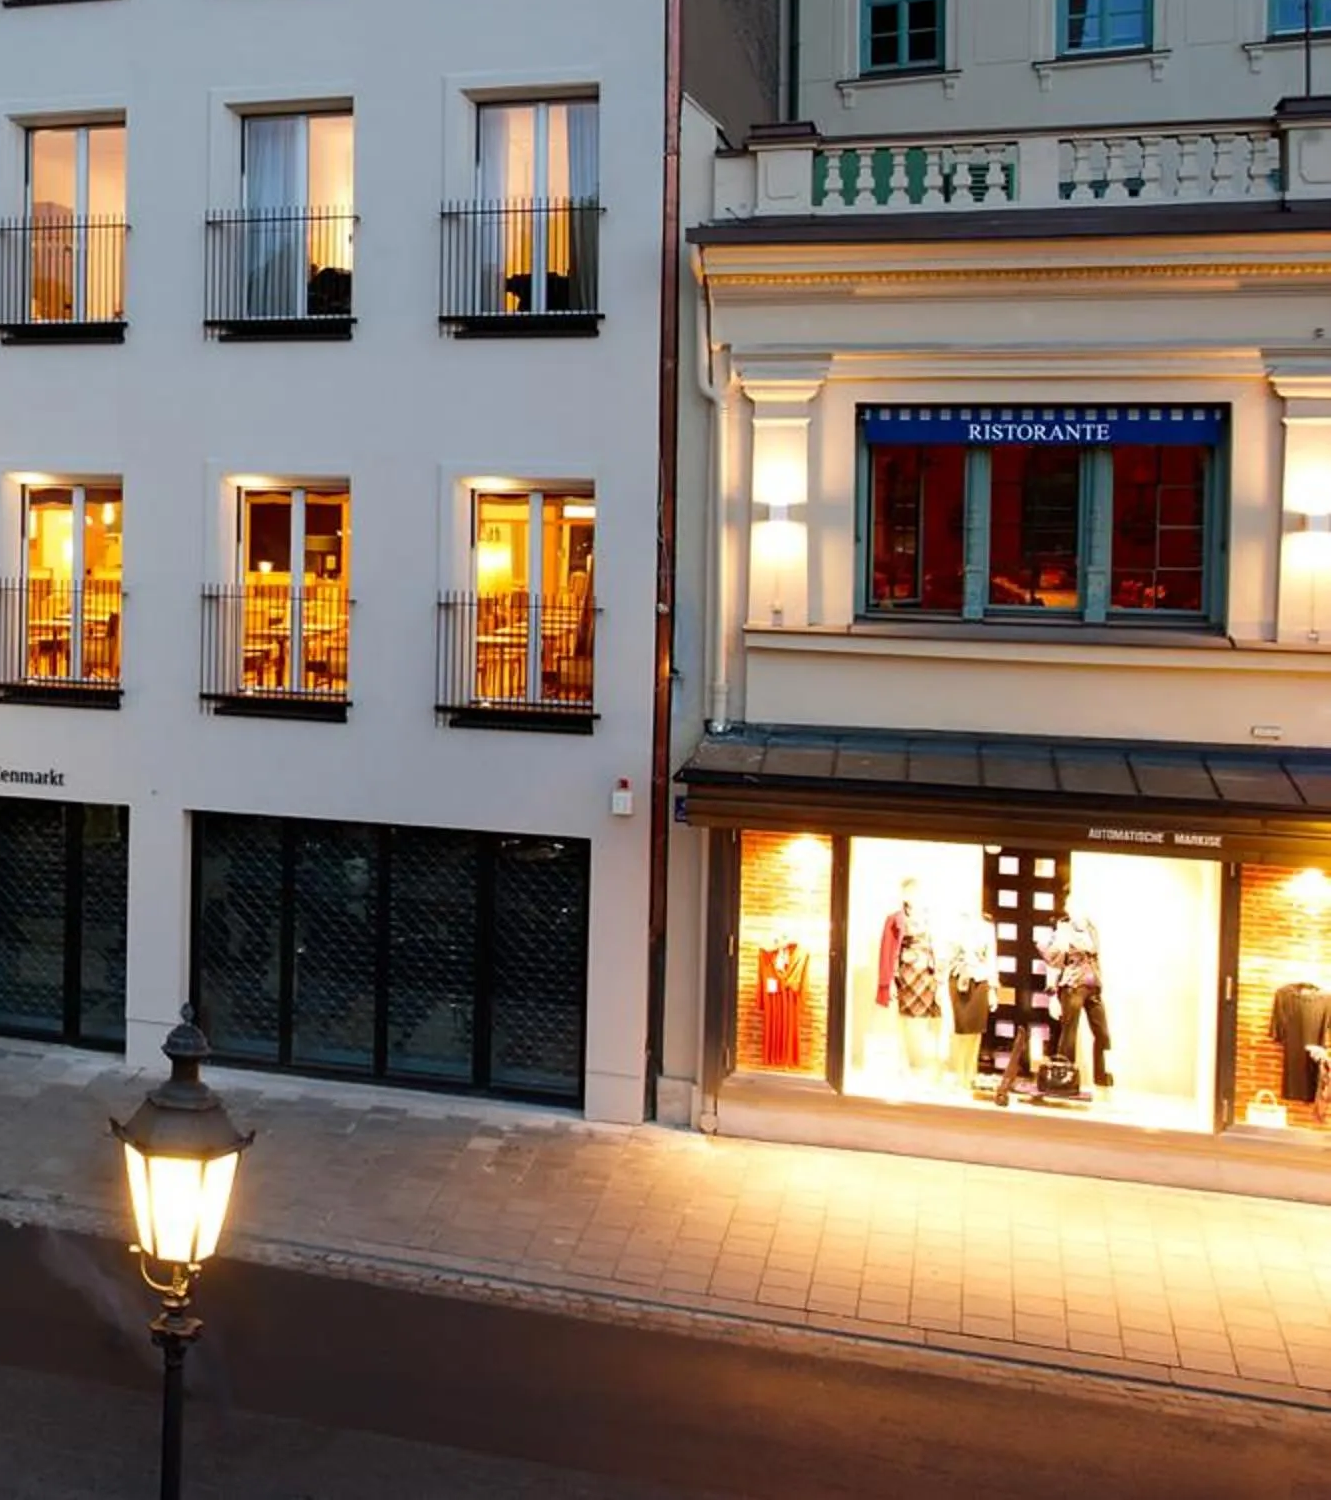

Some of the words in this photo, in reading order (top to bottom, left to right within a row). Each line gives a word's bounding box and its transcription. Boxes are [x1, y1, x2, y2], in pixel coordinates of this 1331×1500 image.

[968, 423, 1111, 442] RISTORANTE
[1087, 827, 1165, 844] AUTOMATISCHE
[1174, 833, 1223, 849] MARKISE
